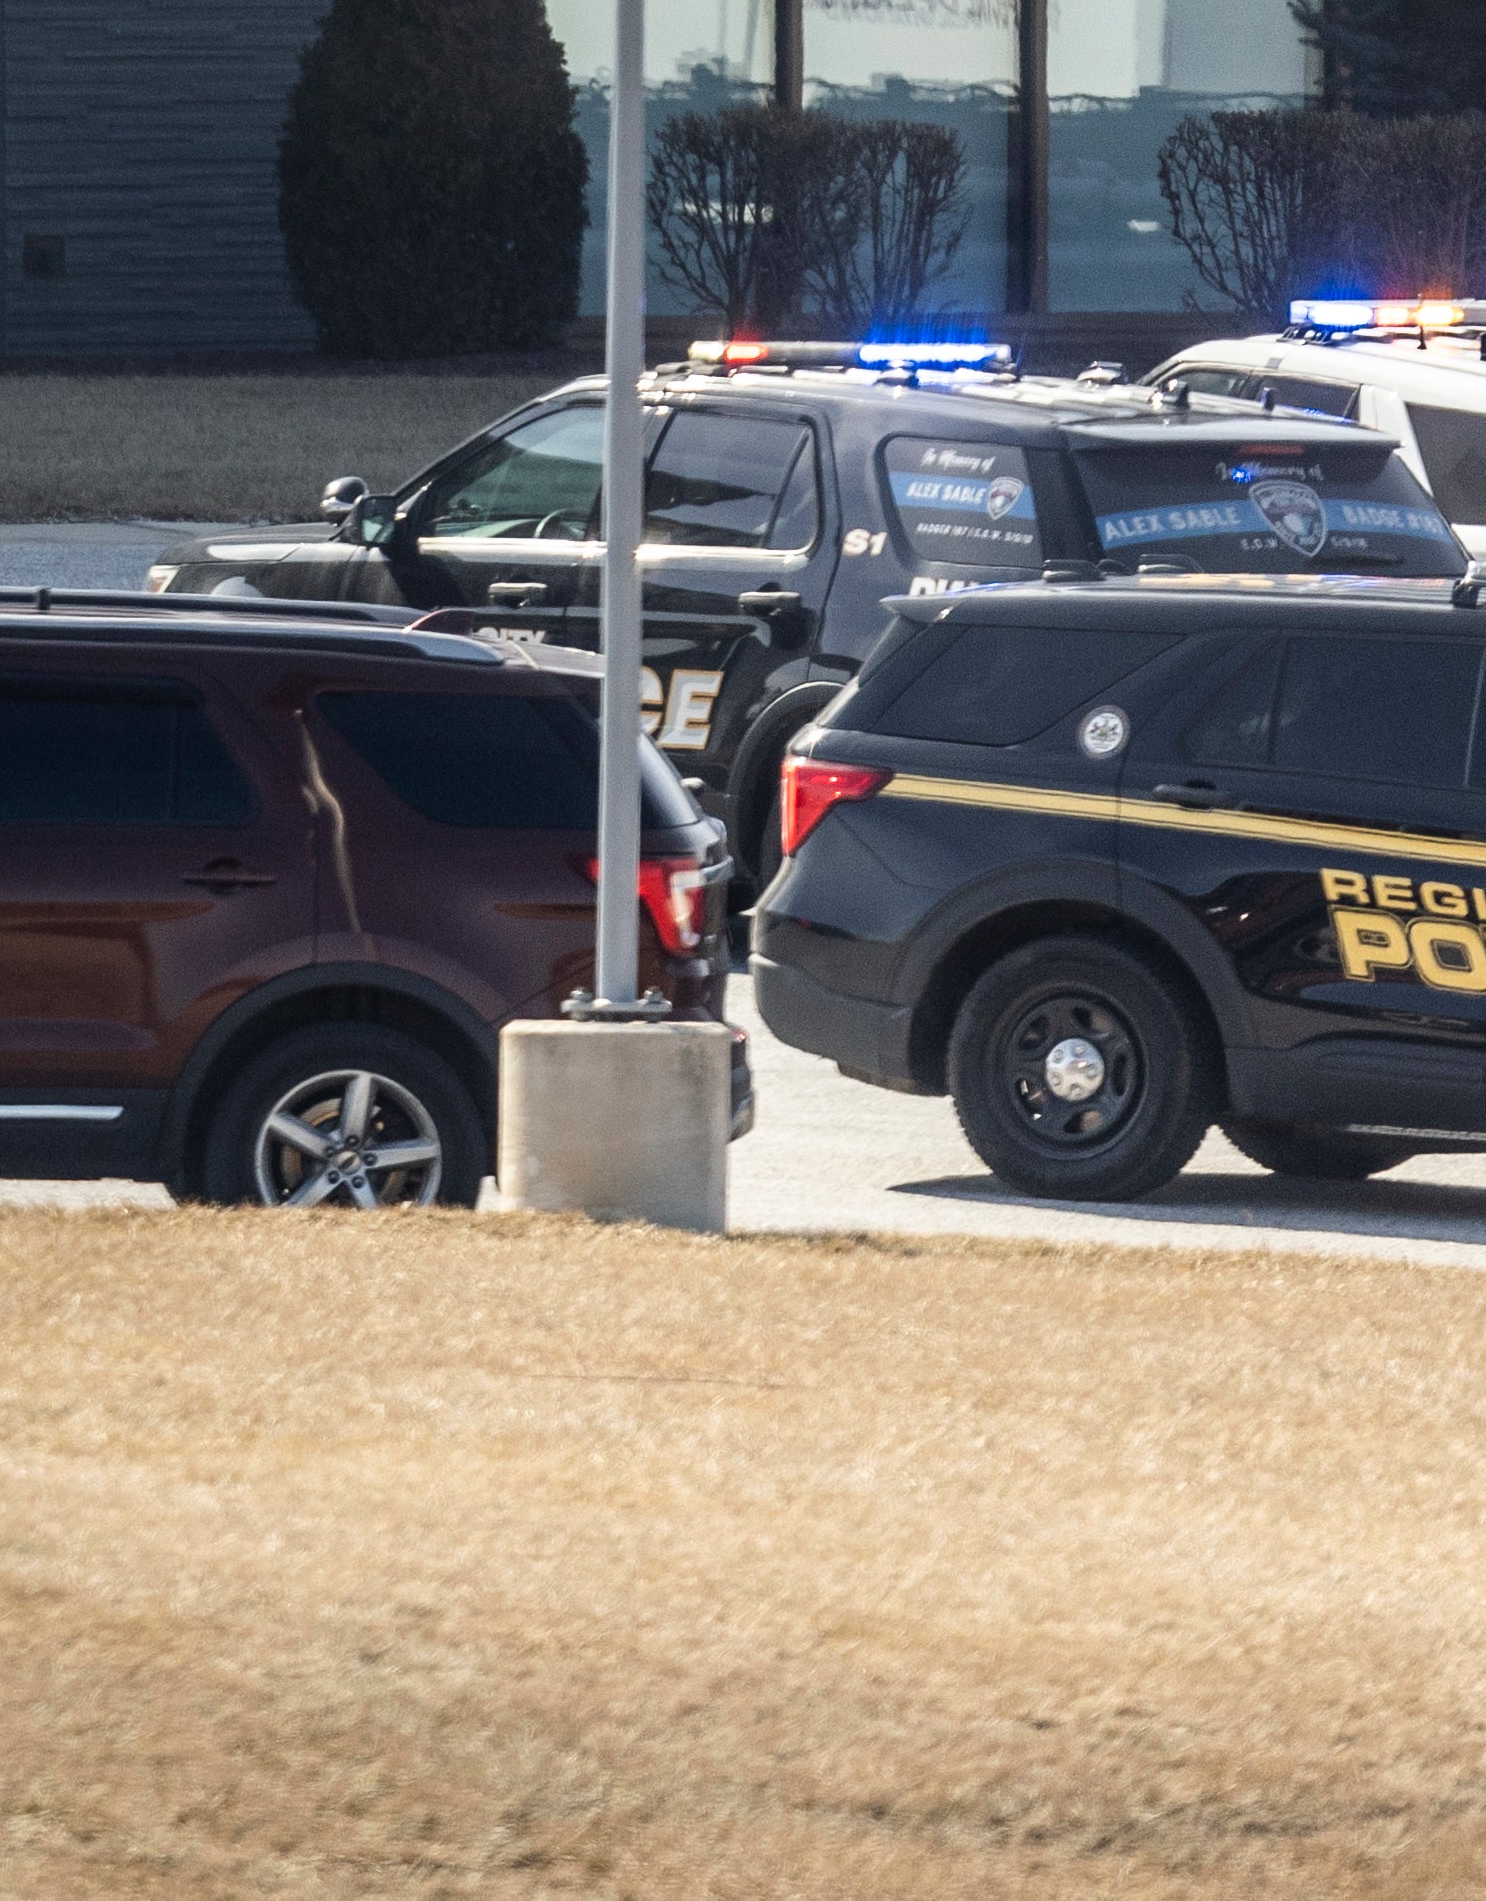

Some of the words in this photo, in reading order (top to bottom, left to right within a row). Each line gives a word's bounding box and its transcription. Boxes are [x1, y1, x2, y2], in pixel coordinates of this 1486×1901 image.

[906, 481, 942, 500] ALEX
[942, 483, 988, 505] SABLE
[1104, 513, 1162, 541] ALEX
[1166, 506, 1241, 530] SABLE
[1342, 505, 1400, 531] BADGE
[842, 527, 888, 558] S1
